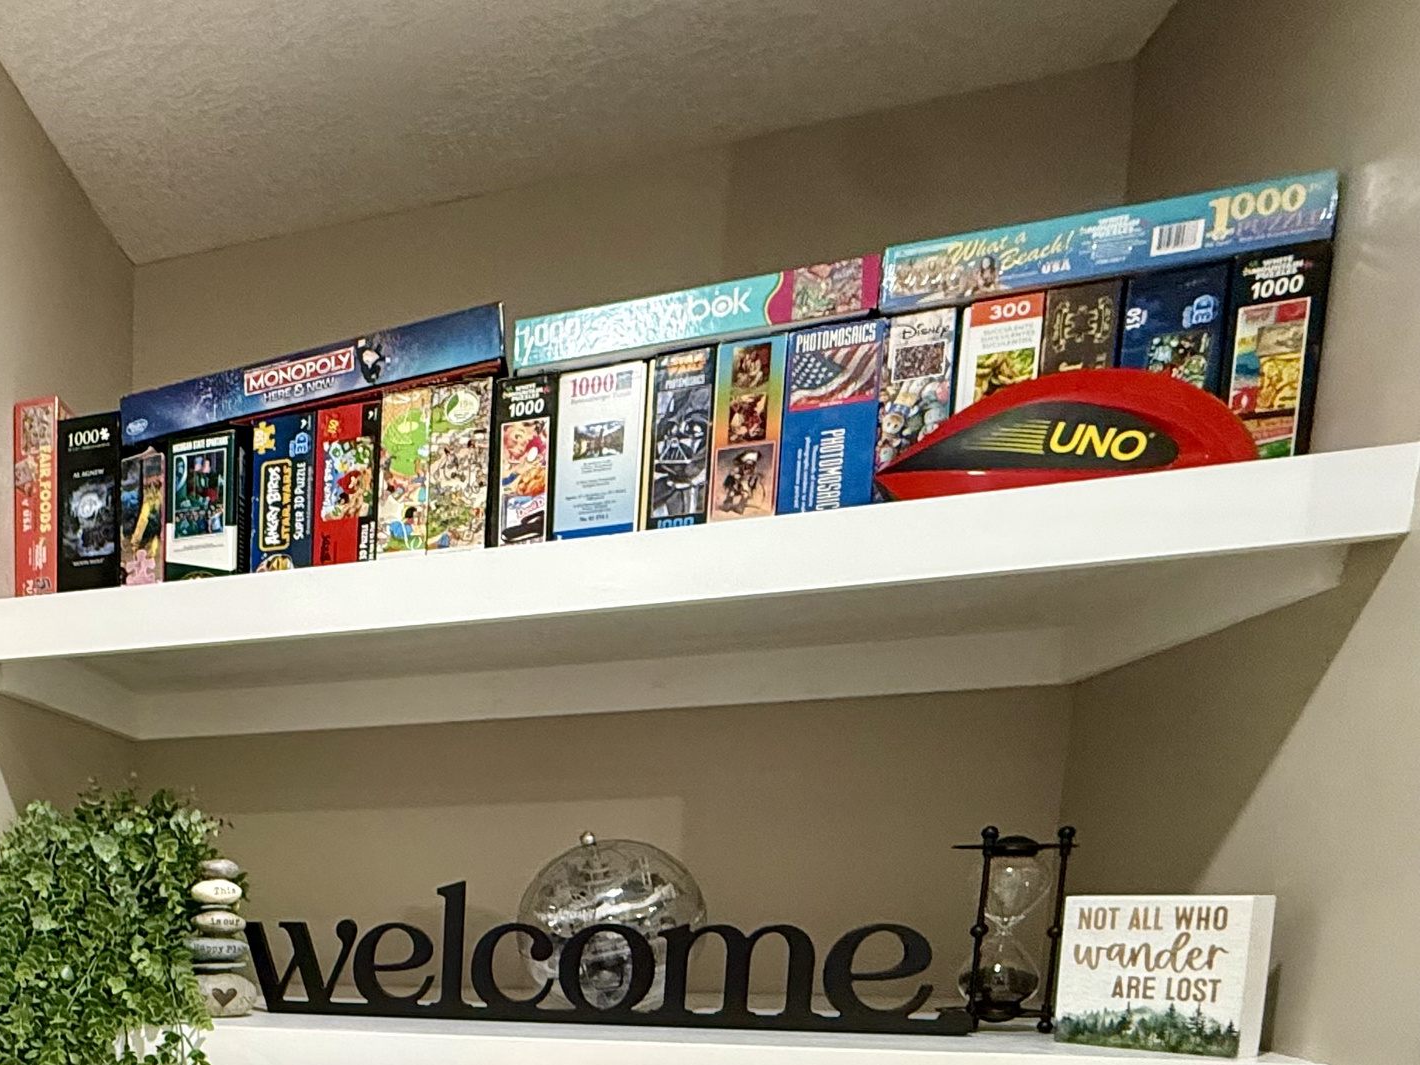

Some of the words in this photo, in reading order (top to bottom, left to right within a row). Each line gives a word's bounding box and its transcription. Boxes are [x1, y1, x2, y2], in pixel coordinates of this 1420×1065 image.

[1209, 184, 1307, 241] 1000
[948, 236, 1008, 265] What
[999, 230, 1075, 270] Beach!
[1041, 259, 1071, 274] USA
[1251, 275, 1305, 300] 1000
[989, 301, 1031, 320] 300
[796, 322, 877, 353] PHOTOMOSAICS
[248, 353, 352, 390] MONOPOLY
[571, 373, 614, 397] 1000
[264, 387, 291, 402] HERE
[306, 377, 336, 392] NOW
[509, 398, 545, 418] 1000
[67, 428, 100, 448] 1000
[1048, 420, 1147, 461] UNO
[38, 445, 52, 477] FAIR
[816, 428, 845, 511] PHOTOMOSAIC
[266, 465, 281, 503] BIRDS
[281, 464, 292, 503] WARS
[295, 461, 307, 494] PUZZLE
[38, 481, 52, 533] FOODS
[265, 505, 281, 545] ANGRY
[281, 504, 292, 542] STAR
[294, 511, 305, 541] SUPER
[213, 886, 237, 896] This
[224, 918, 240, 927] our
[1077, 906, 1121, 931] NOT
[1127, 906, 1164, 931] ALL
[1174, 905, 1229, 931] WHO
[193, 942, 227, 955] Happy
[246, 880, 935, 1019] welcome
[1073, 932, 1230, 973] wander
[1111, 975, 1157, 1000] ARE
[1165, 977, 1222, 1003] LOST
